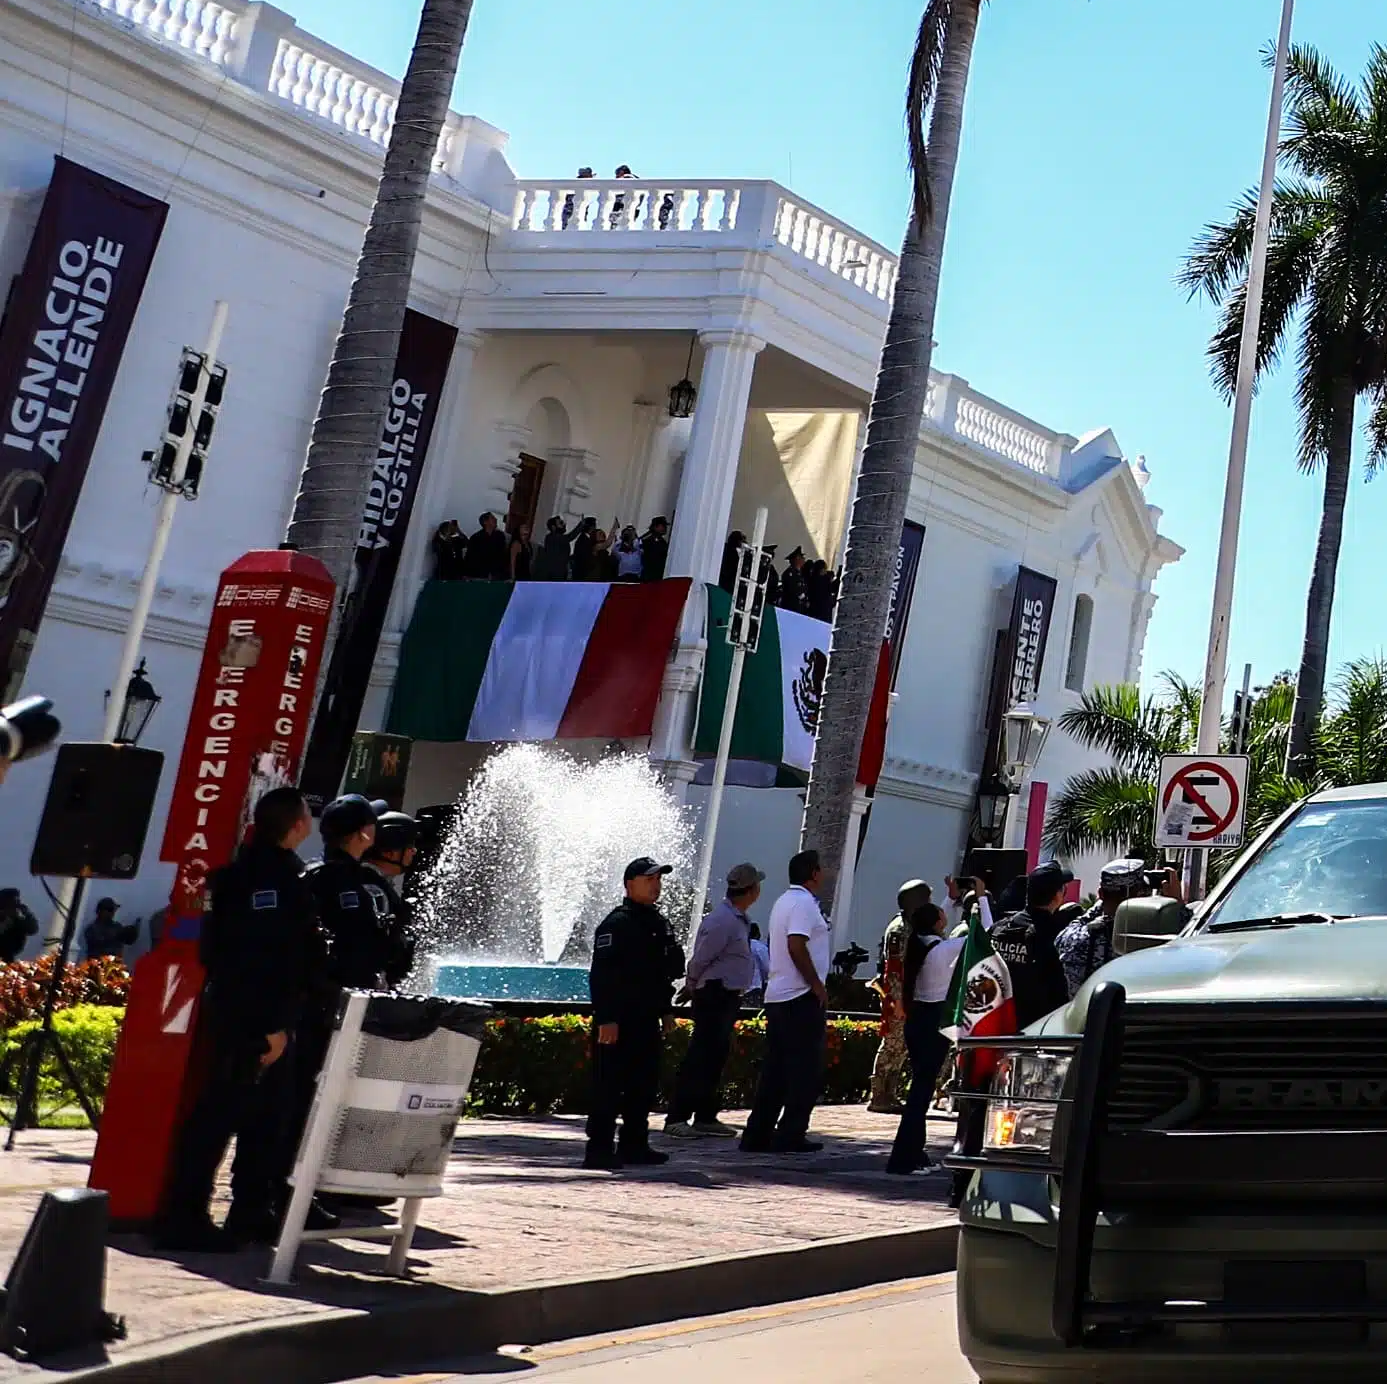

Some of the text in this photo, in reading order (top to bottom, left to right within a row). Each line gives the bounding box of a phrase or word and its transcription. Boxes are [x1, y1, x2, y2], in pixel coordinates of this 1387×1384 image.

[3, 240, 89, 452] IGNACIO
[38, 236, 125, 463] ALLENDE
[357, 378, 412, 549] HIDALGO
[382, 393, 428, 527] COSTILLA
[184, 619, 257, 850] EERGENCIA
[993, 940, 1028, 956] OLICÍA
